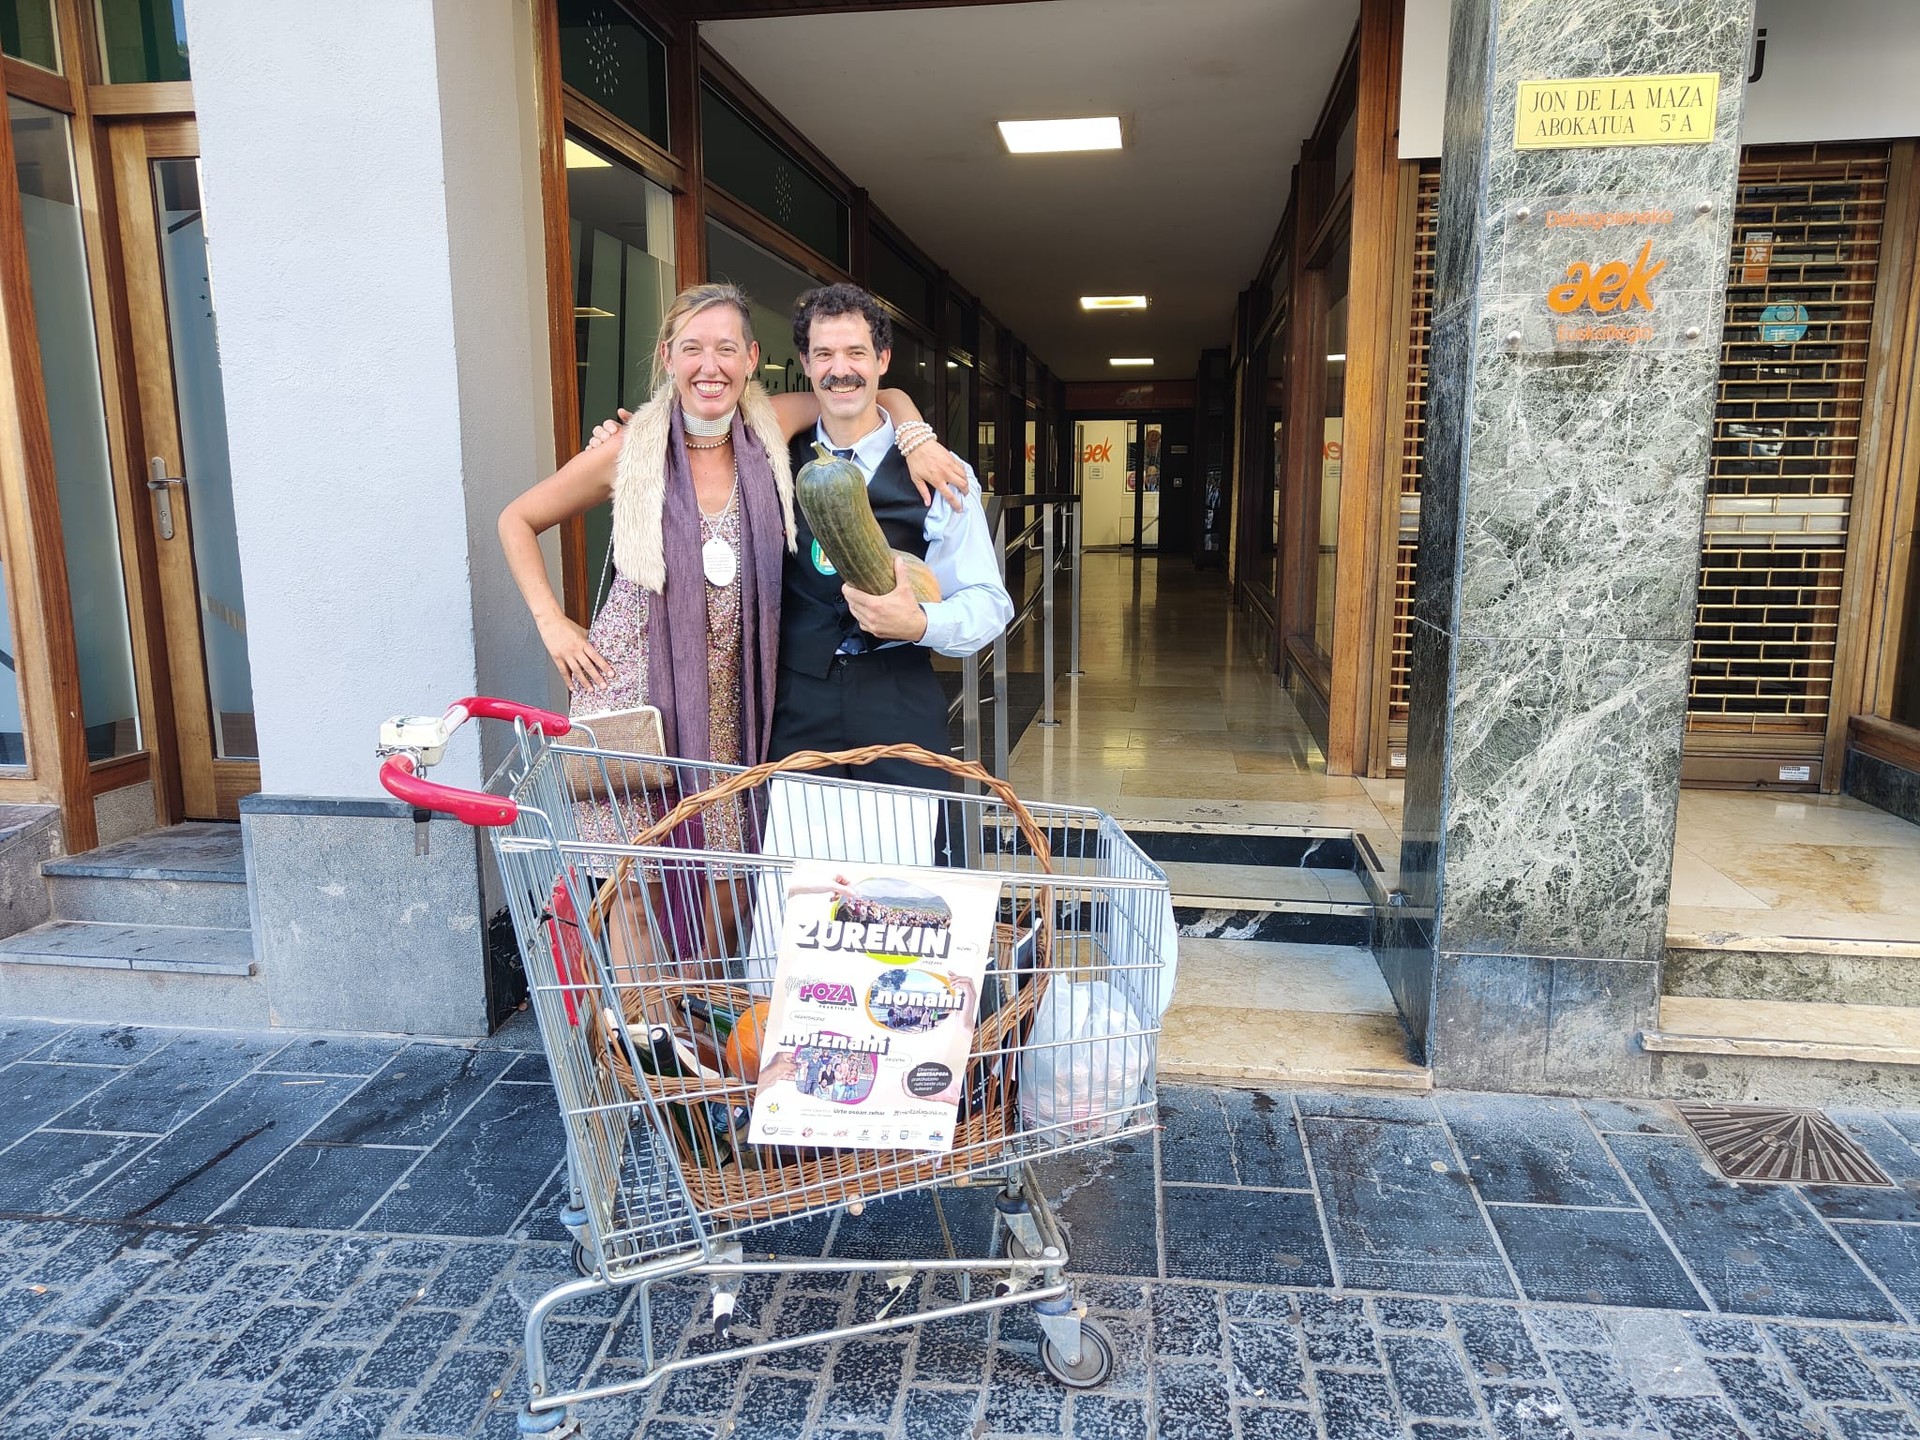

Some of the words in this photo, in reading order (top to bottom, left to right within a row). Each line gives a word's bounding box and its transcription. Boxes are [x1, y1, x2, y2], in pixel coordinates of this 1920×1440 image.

[1529, 90, 1567, 113] JON
[1576, 89, 1601, 112] DE
[1611, 88, 1635, 110] LA
[1645, 86, 1704, 109] MAZA
[1535, 115, 1636, 137] ABOKATUA
[1680, 114, 1693, 133] A
[1547, 238, 1667, 314] aek
[1083, 435, 1113, 464] aek
[795, 919, 952, 960] ZUREKIN
[798, 982, 858, 1007] POZA
[874, 985, 965, 1011] nonahi
